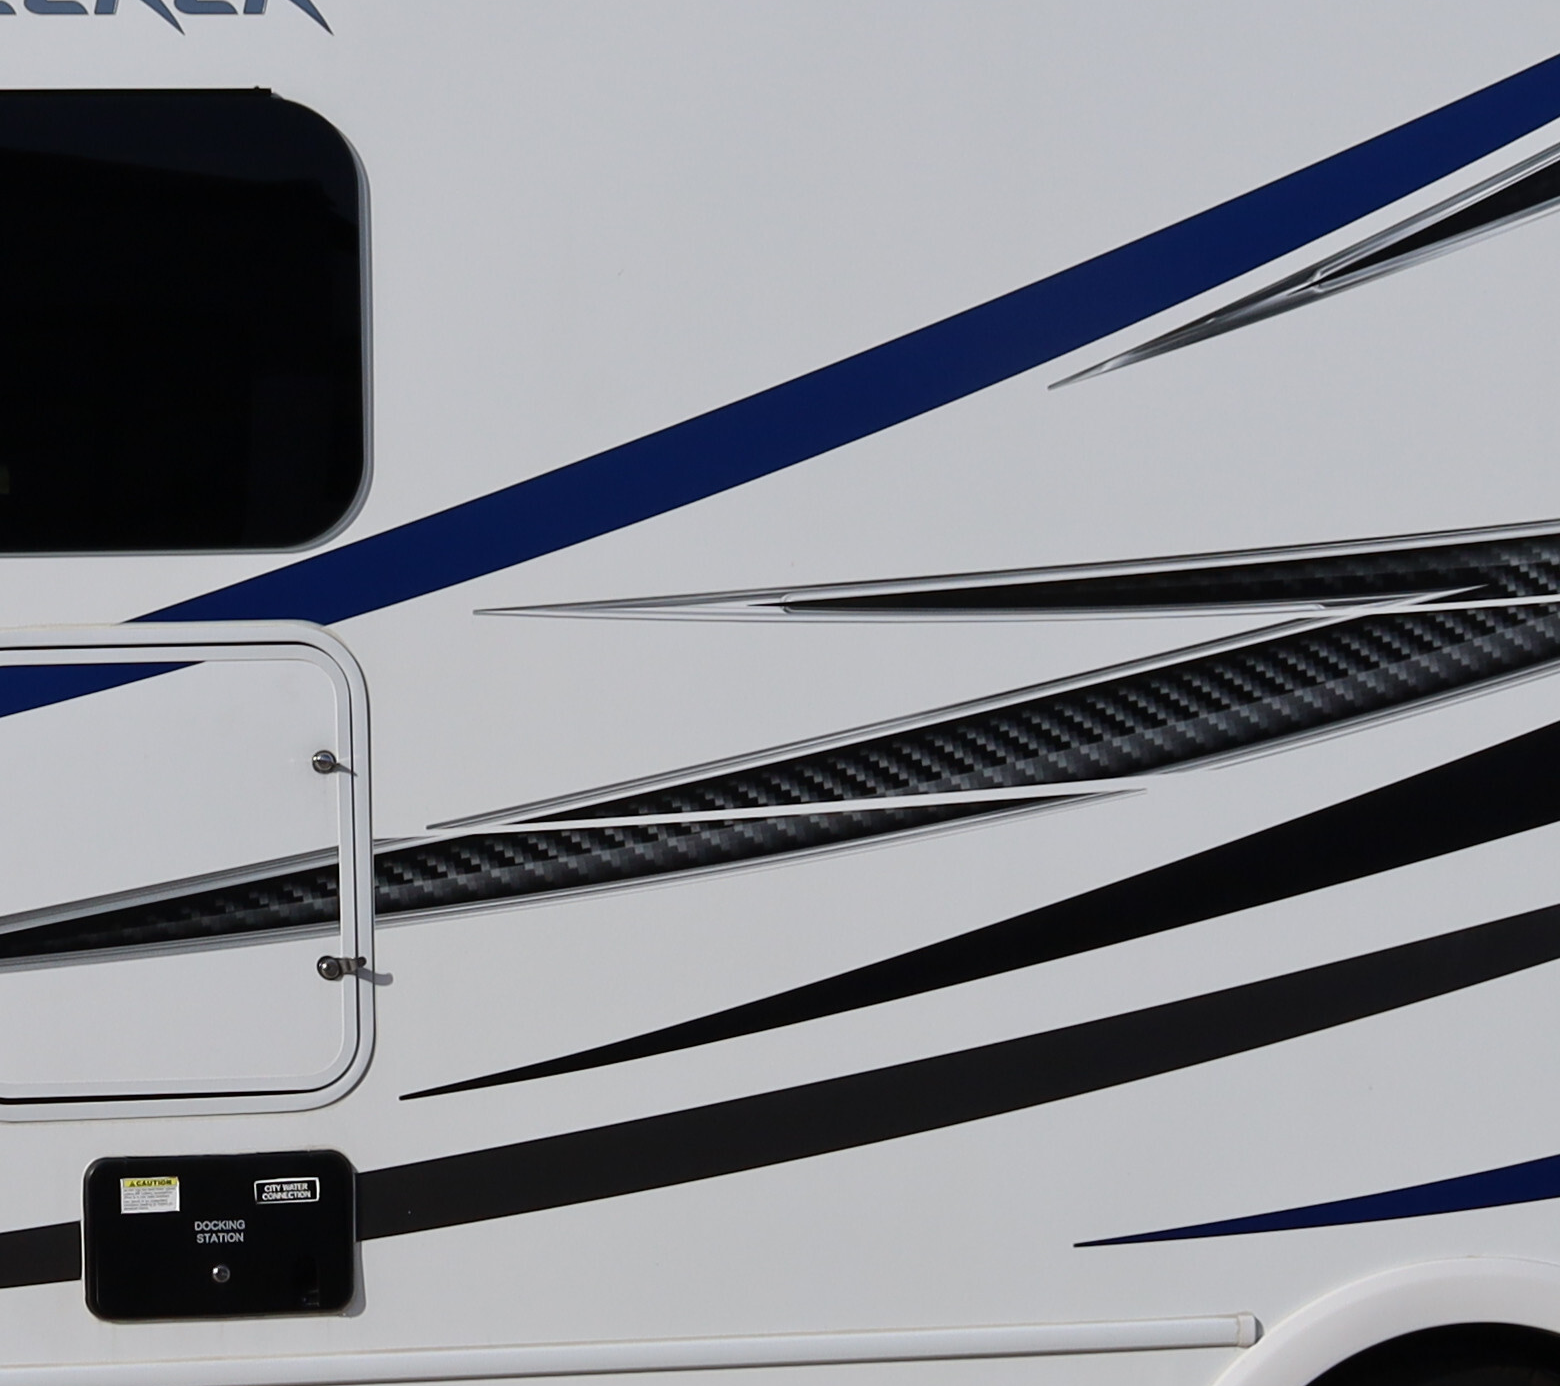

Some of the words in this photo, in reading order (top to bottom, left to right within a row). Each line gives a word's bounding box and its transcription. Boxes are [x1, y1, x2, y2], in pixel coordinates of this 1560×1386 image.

[136, 1179, 172, 1187] CAUTION
[264, 1184, 281, 1192] CITY
[282, 1182, 308, 1191] WATER
[262, 1190, 312, 1201] CONNECTION
[194, 1219, 246, 1231] DOCKING
[196, 1231, 245, 1243] STATION
